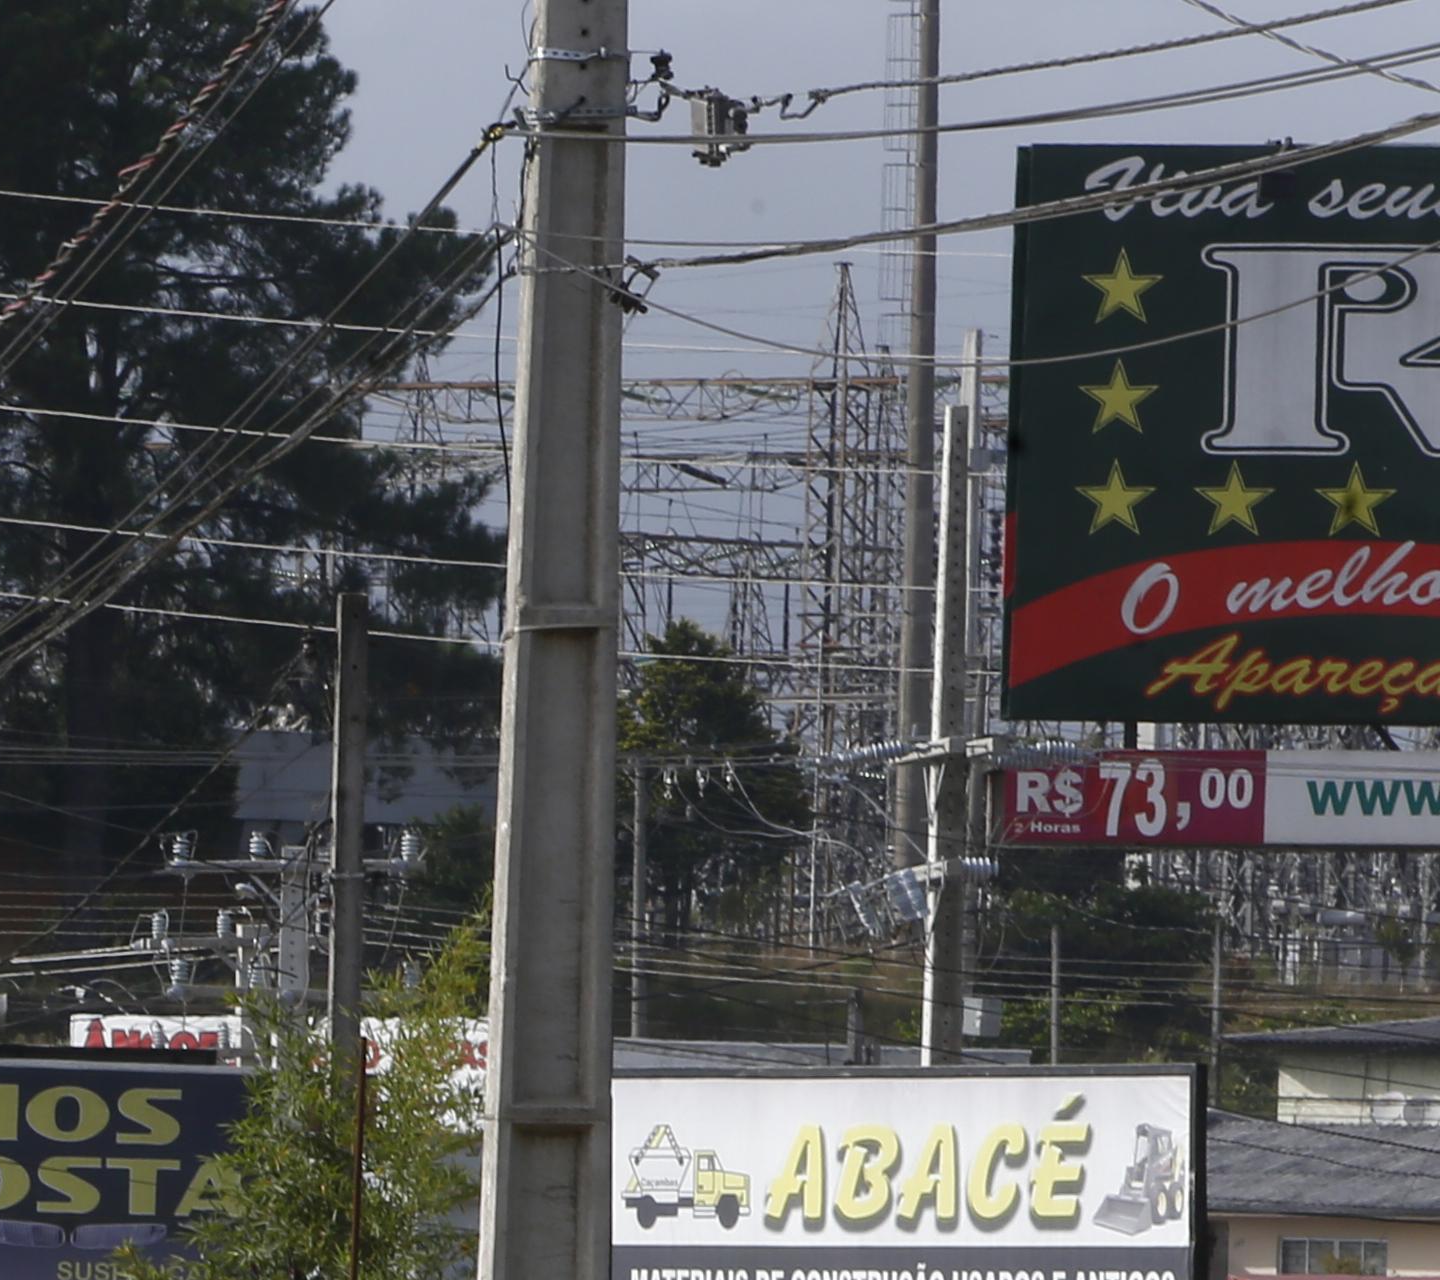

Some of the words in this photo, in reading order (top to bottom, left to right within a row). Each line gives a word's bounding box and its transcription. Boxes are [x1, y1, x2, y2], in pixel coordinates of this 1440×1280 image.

[1084, 156, 1274, 222] Viva
[1121, 562, 1179, 635] O
[1016, 771, 1084, 818] R$
[1030, 820, 1081, 834] Horas
[641, 1177, 679, 1190] Caçambas
[764, 1091, 1091, 1229] ABACÉ
